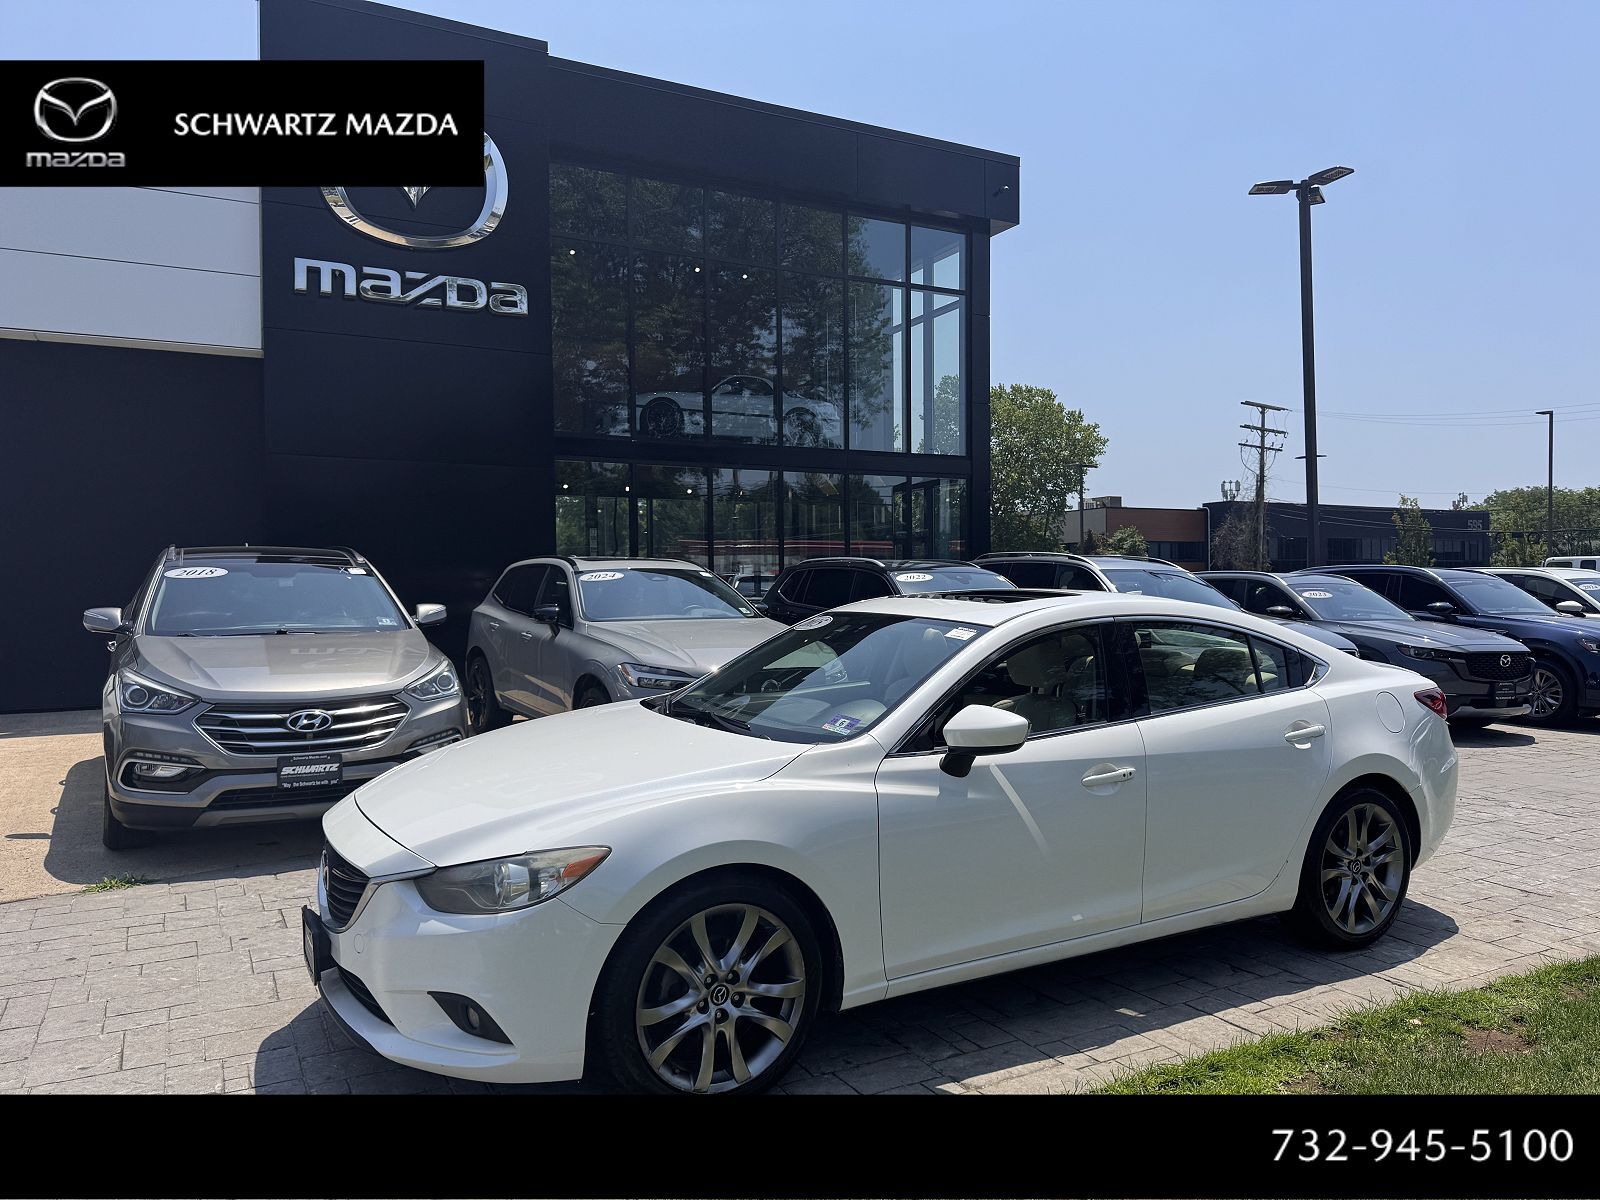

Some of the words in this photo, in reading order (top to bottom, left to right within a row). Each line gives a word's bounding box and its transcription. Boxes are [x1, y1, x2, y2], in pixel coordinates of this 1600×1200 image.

[1467, 519, 1483, 530] 595
[174, 568, 218, 577] 2018
[586, 572, 617, 580] 2024
[281, 763, 340, 774] SCHWARTZ
